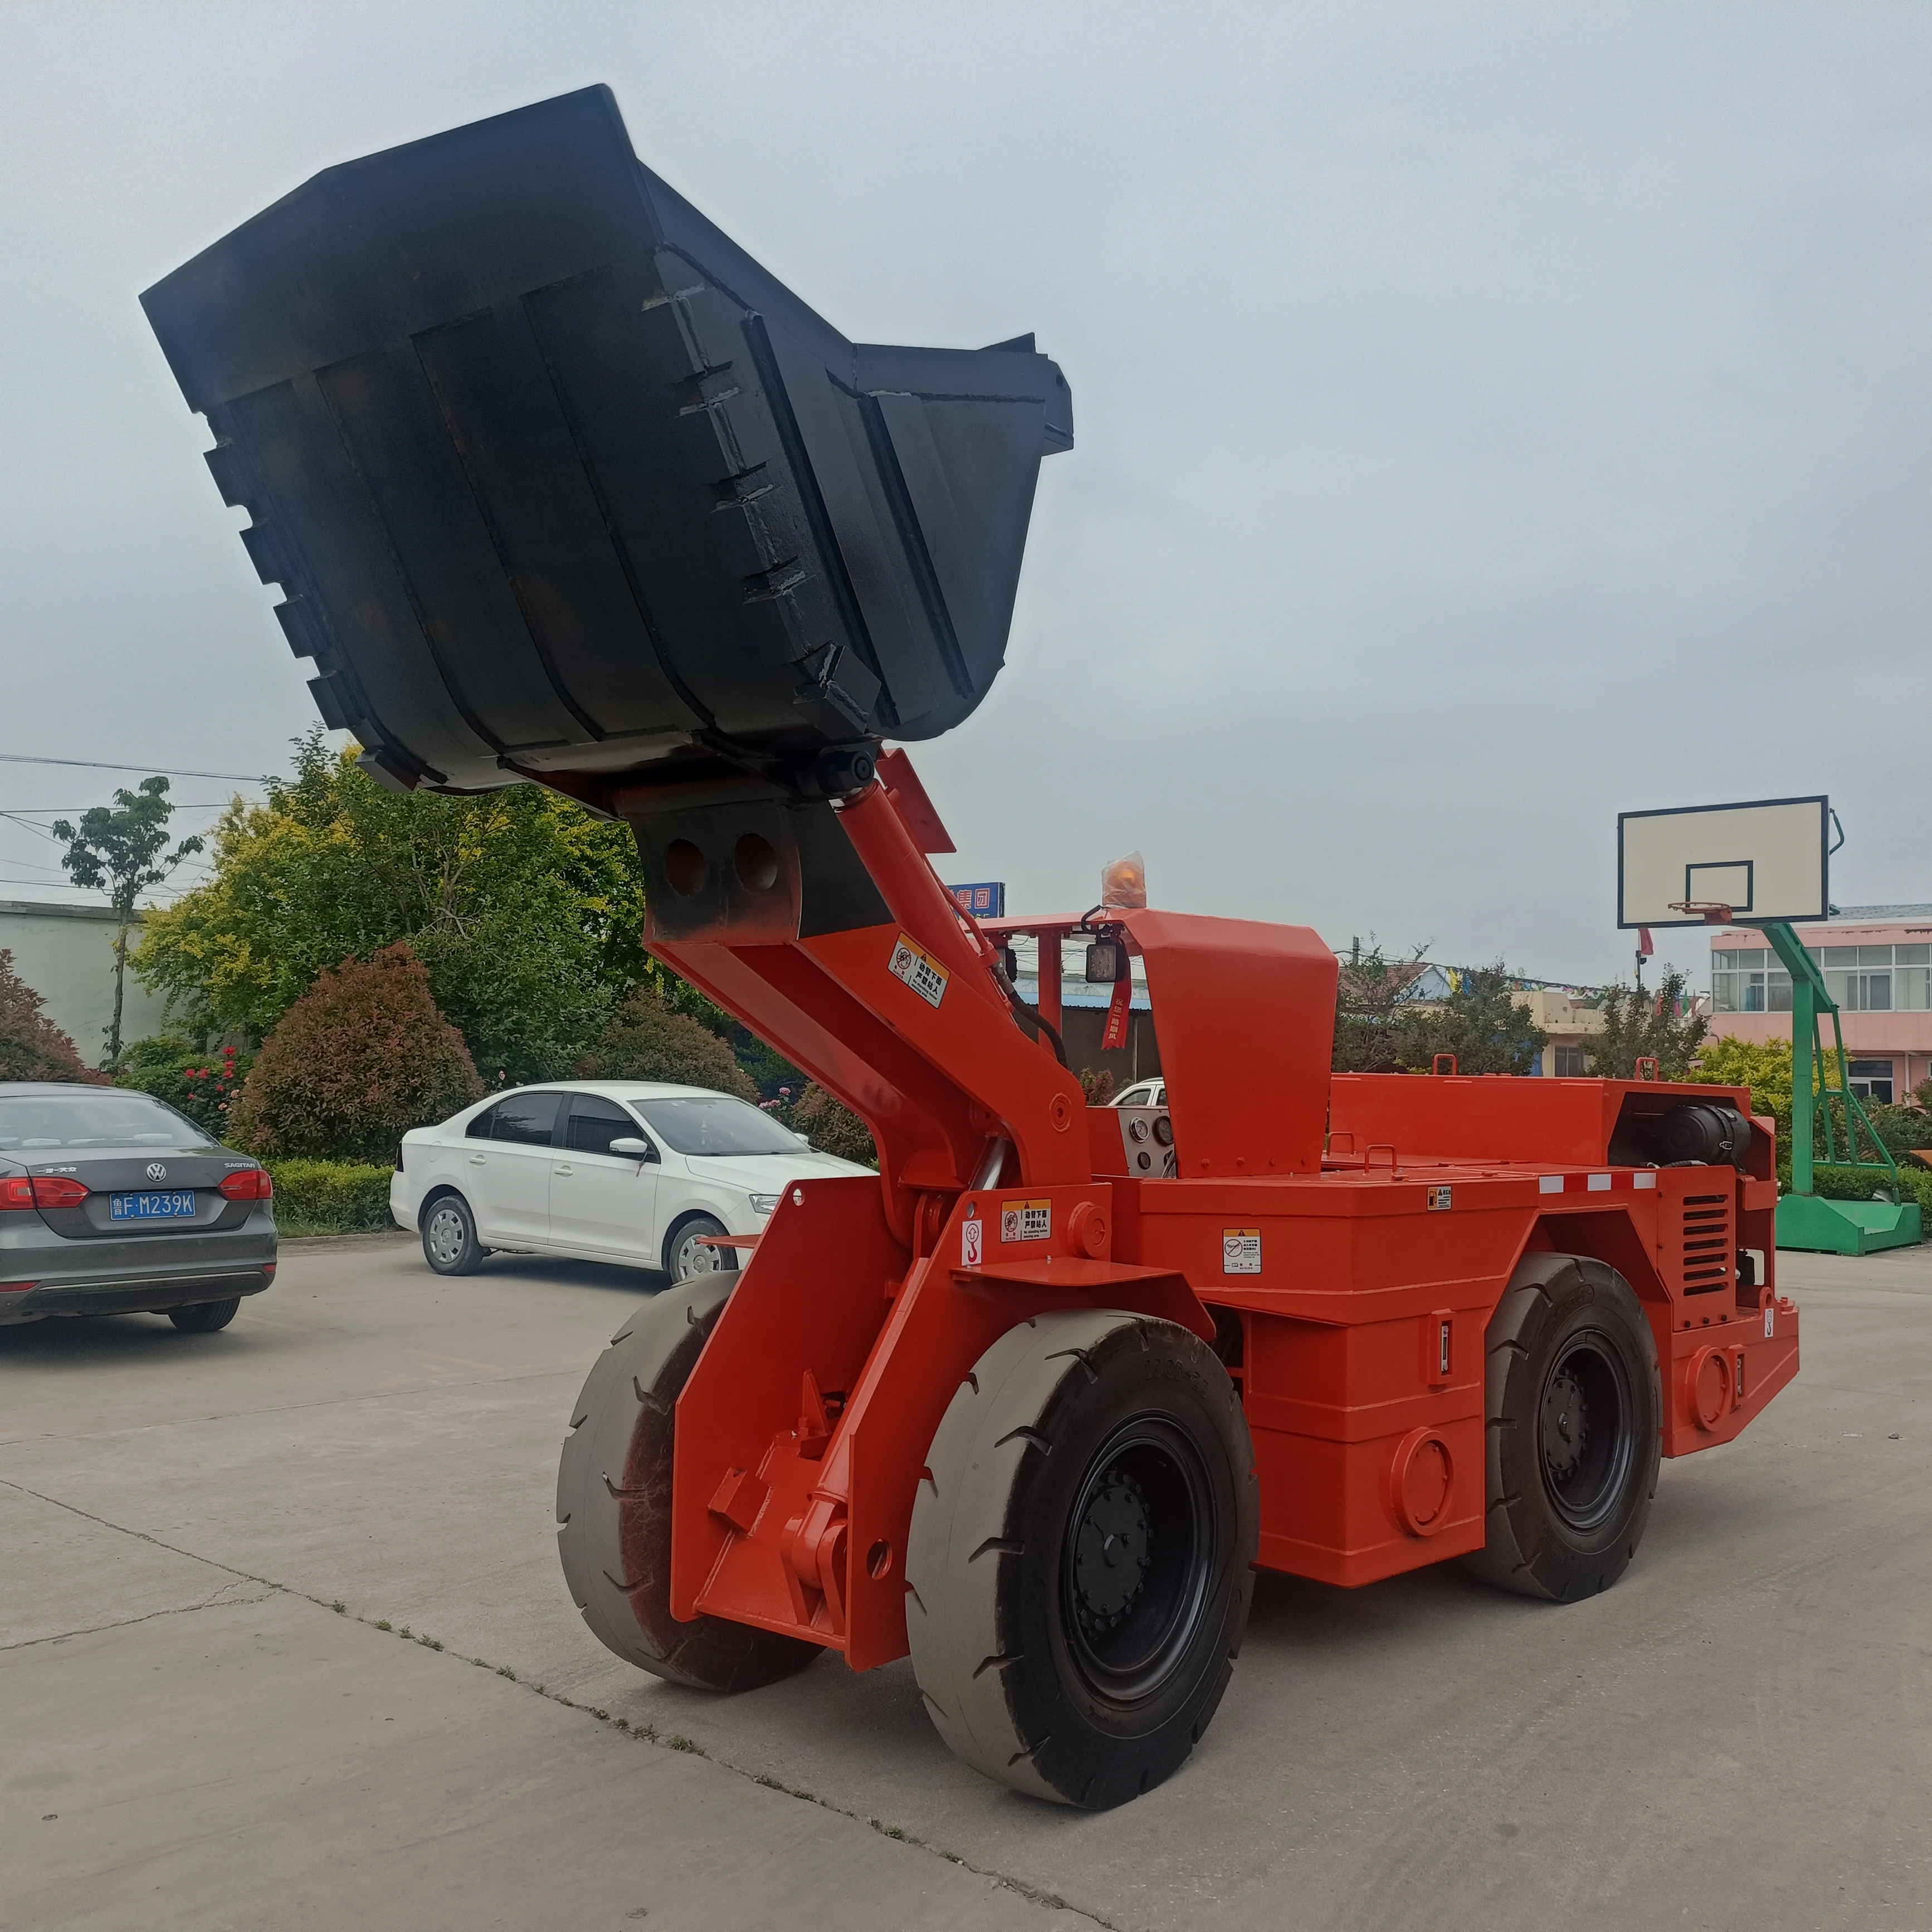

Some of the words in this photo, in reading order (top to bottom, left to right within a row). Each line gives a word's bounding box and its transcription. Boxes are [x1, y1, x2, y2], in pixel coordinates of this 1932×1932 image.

[949, 888, 990, 909] 集团
[915, 971, 938, 996] 严禁站人
[919, 962, 943, 986] 动臂下面
[1108, 998, 1124, 1040] 祝您一路顺风
[1025, 1210, 1047, 1219] 动臂下面
